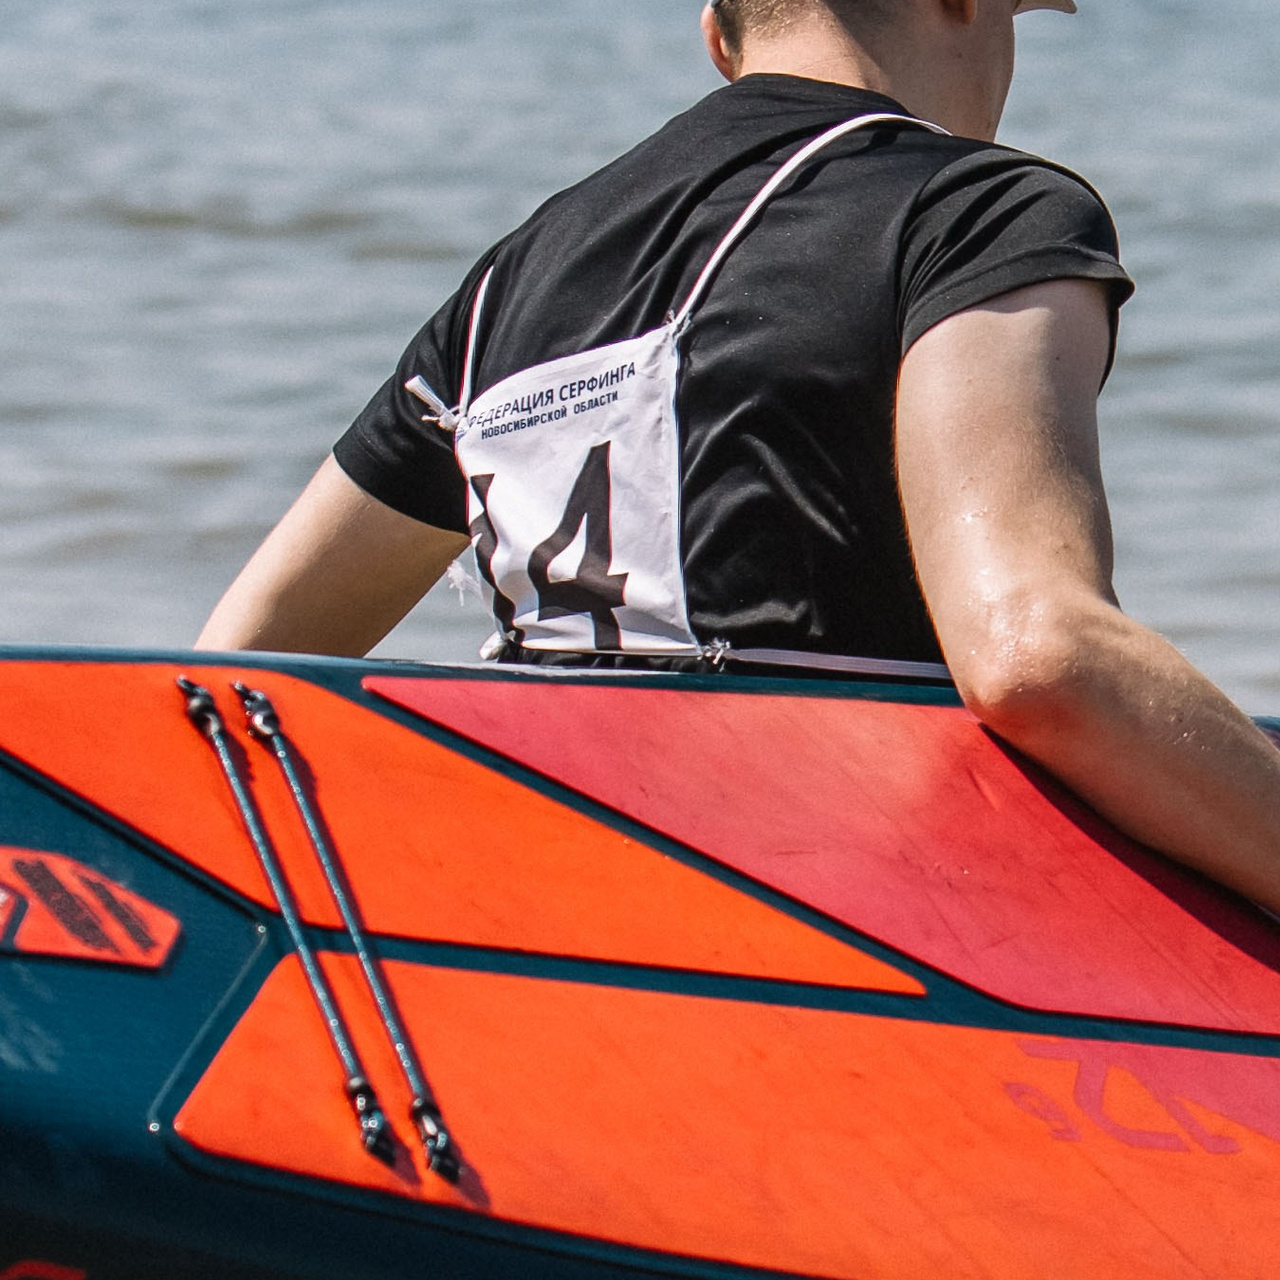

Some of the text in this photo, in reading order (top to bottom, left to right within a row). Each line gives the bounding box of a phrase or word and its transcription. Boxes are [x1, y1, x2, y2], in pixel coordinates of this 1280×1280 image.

[559, 361, 636, 402] СЕРФИНГА
[481, 390, 618, 440] НОВОСИБИРСКОЙ ОБЛАСТИ
